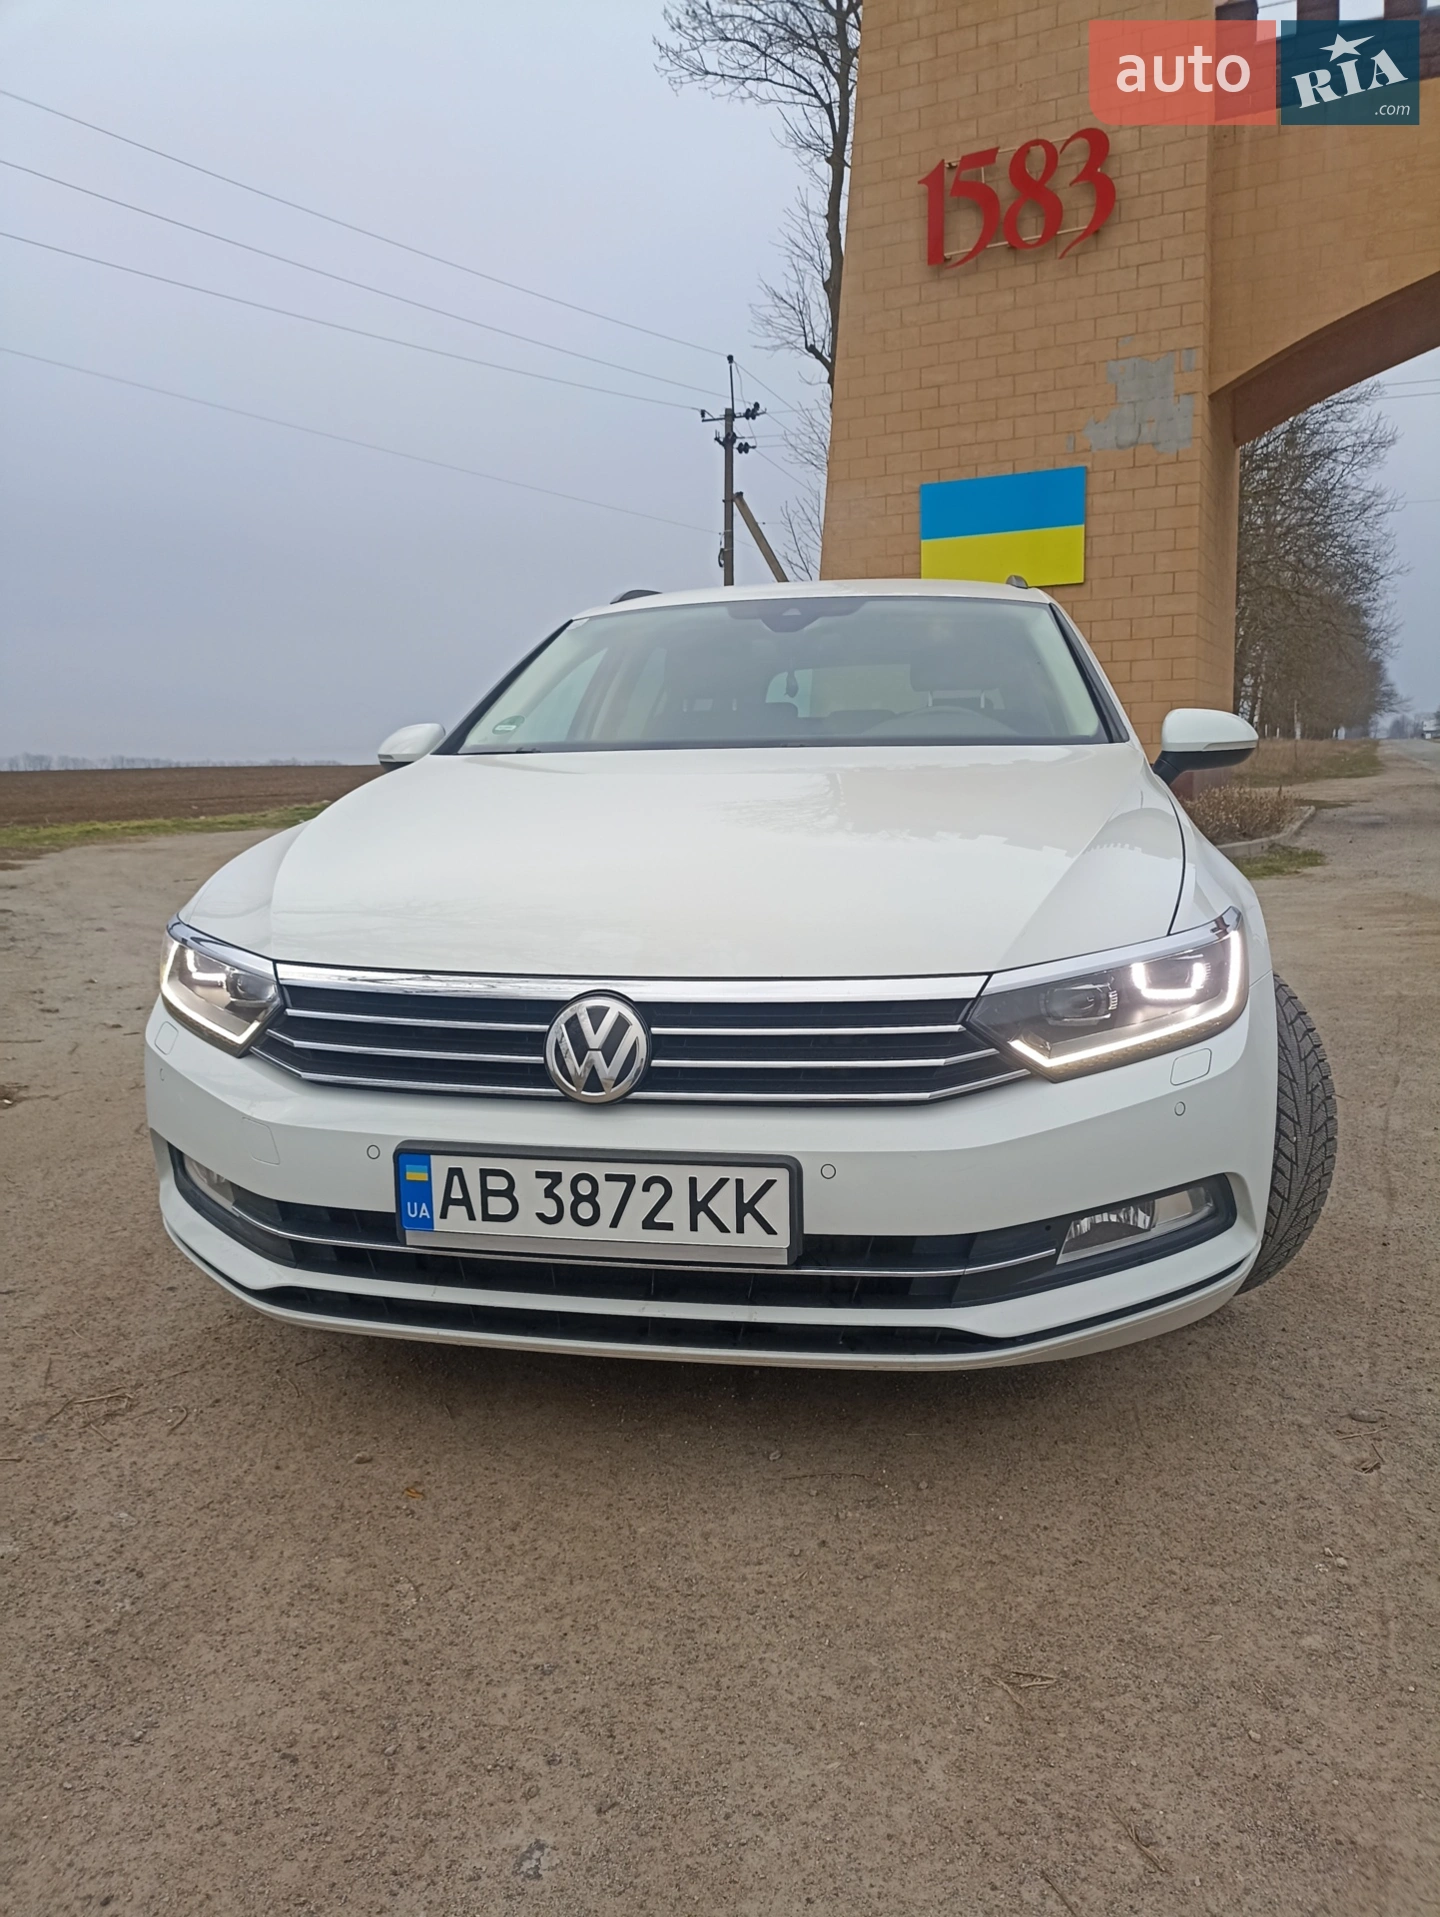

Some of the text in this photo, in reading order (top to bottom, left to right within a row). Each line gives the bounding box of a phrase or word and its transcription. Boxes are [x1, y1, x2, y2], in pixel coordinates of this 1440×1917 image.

[917, 127, 1116, 269] 1583
[407, 1202, 431, 1219] UA
[439, 1166, 779, 1236] AB 3872 KK
